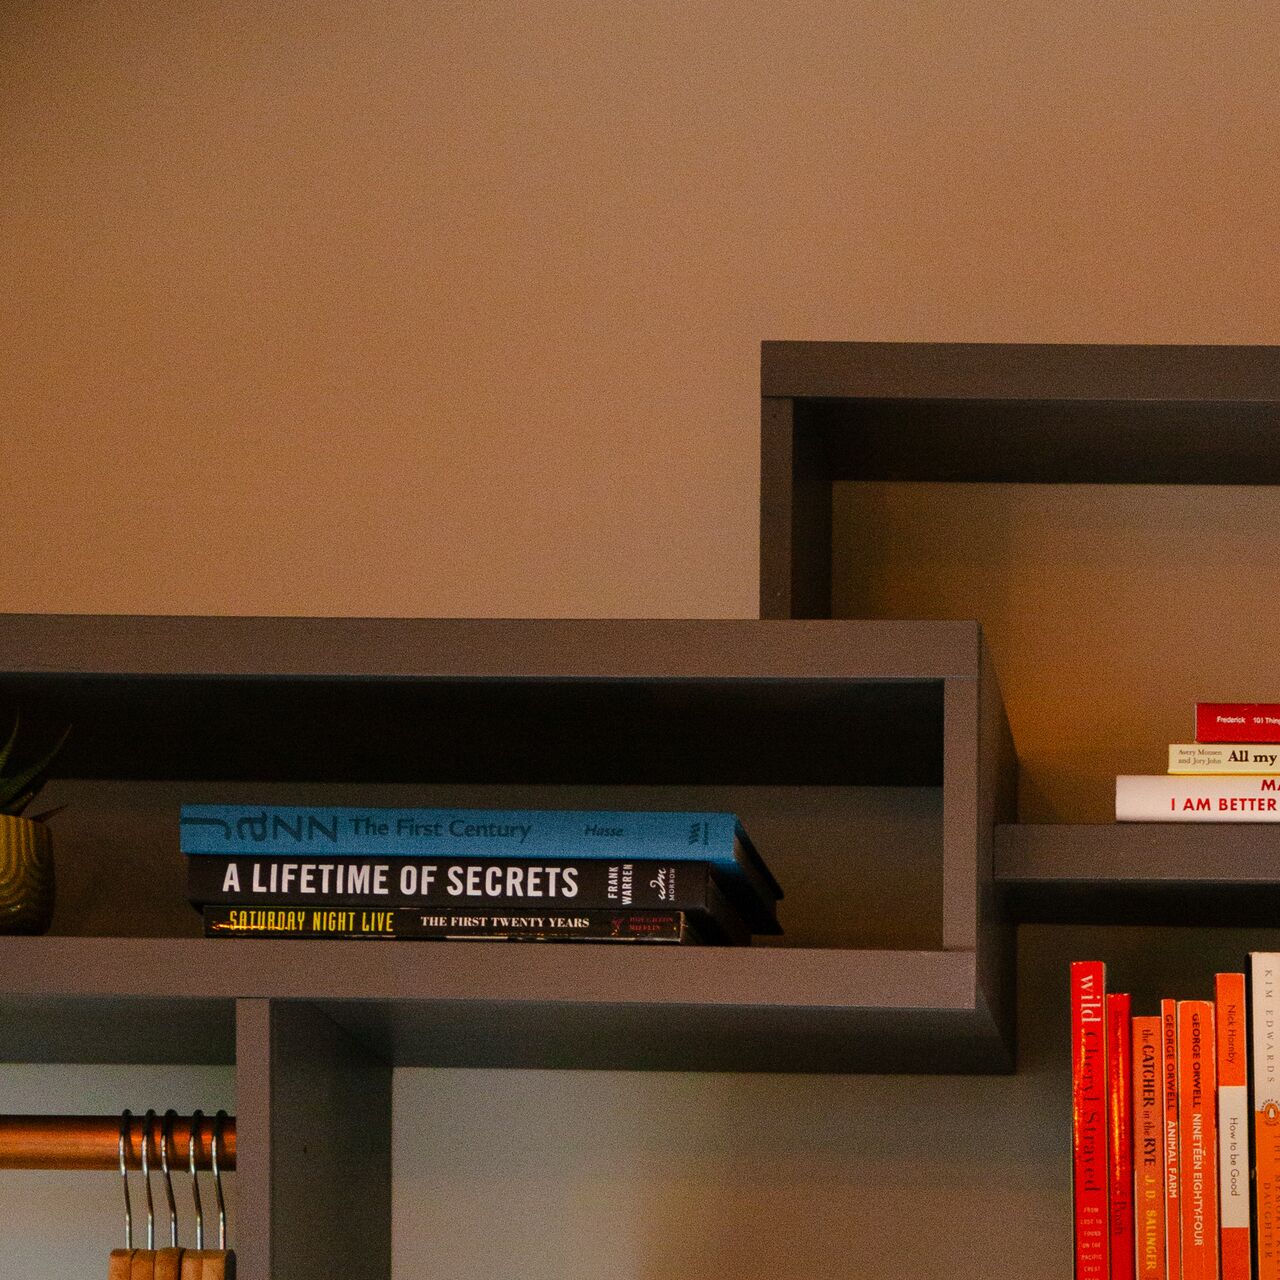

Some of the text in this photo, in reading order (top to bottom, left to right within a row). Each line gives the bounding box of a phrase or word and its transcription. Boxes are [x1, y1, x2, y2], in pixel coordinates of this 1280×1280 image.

[1228, 751, 1248, 762] All
[1253, 754, 1277, 766] my
[1171, 799, 1175, 810] I
[1183, 799, 1211, 810] AM
[1219, 799, 1276, 810] BETTER
[352, 818, 388, 835] The
[397, 819, 442, 836] First
[450, 820, 532, 843] Century
[222, 863, 578, 897] A LIFETIME OF SECRETS
[608, 866, 618, 899] FRANK
[622, 864, 633, 905] WARREN
[230, 911, 394, 931] SATURDAY NIGHT LIVE
[420, 916, 589, 927] THE FIRST TWENTY YEARS
[1142, 1029, 1153, 1043] the
[1142, 1045, 1154, 1107] CATCHER
[1192, 1013, 1201, 1108] GEORGE ORWELL
[1080, 975, 1102, 1192] wild Cheryl Strayed
[1143, 1121, 1154, 1135] the
[1144, 1138, 1156, 1166] RYE
[1168, 1120, 1178, 1198] ANIMAL FARM
[1229, 1118, 1240, 1196] How to be Good
[1193, 1114, 1203, 1246] NINETEEN EIGHTY-FOUR
